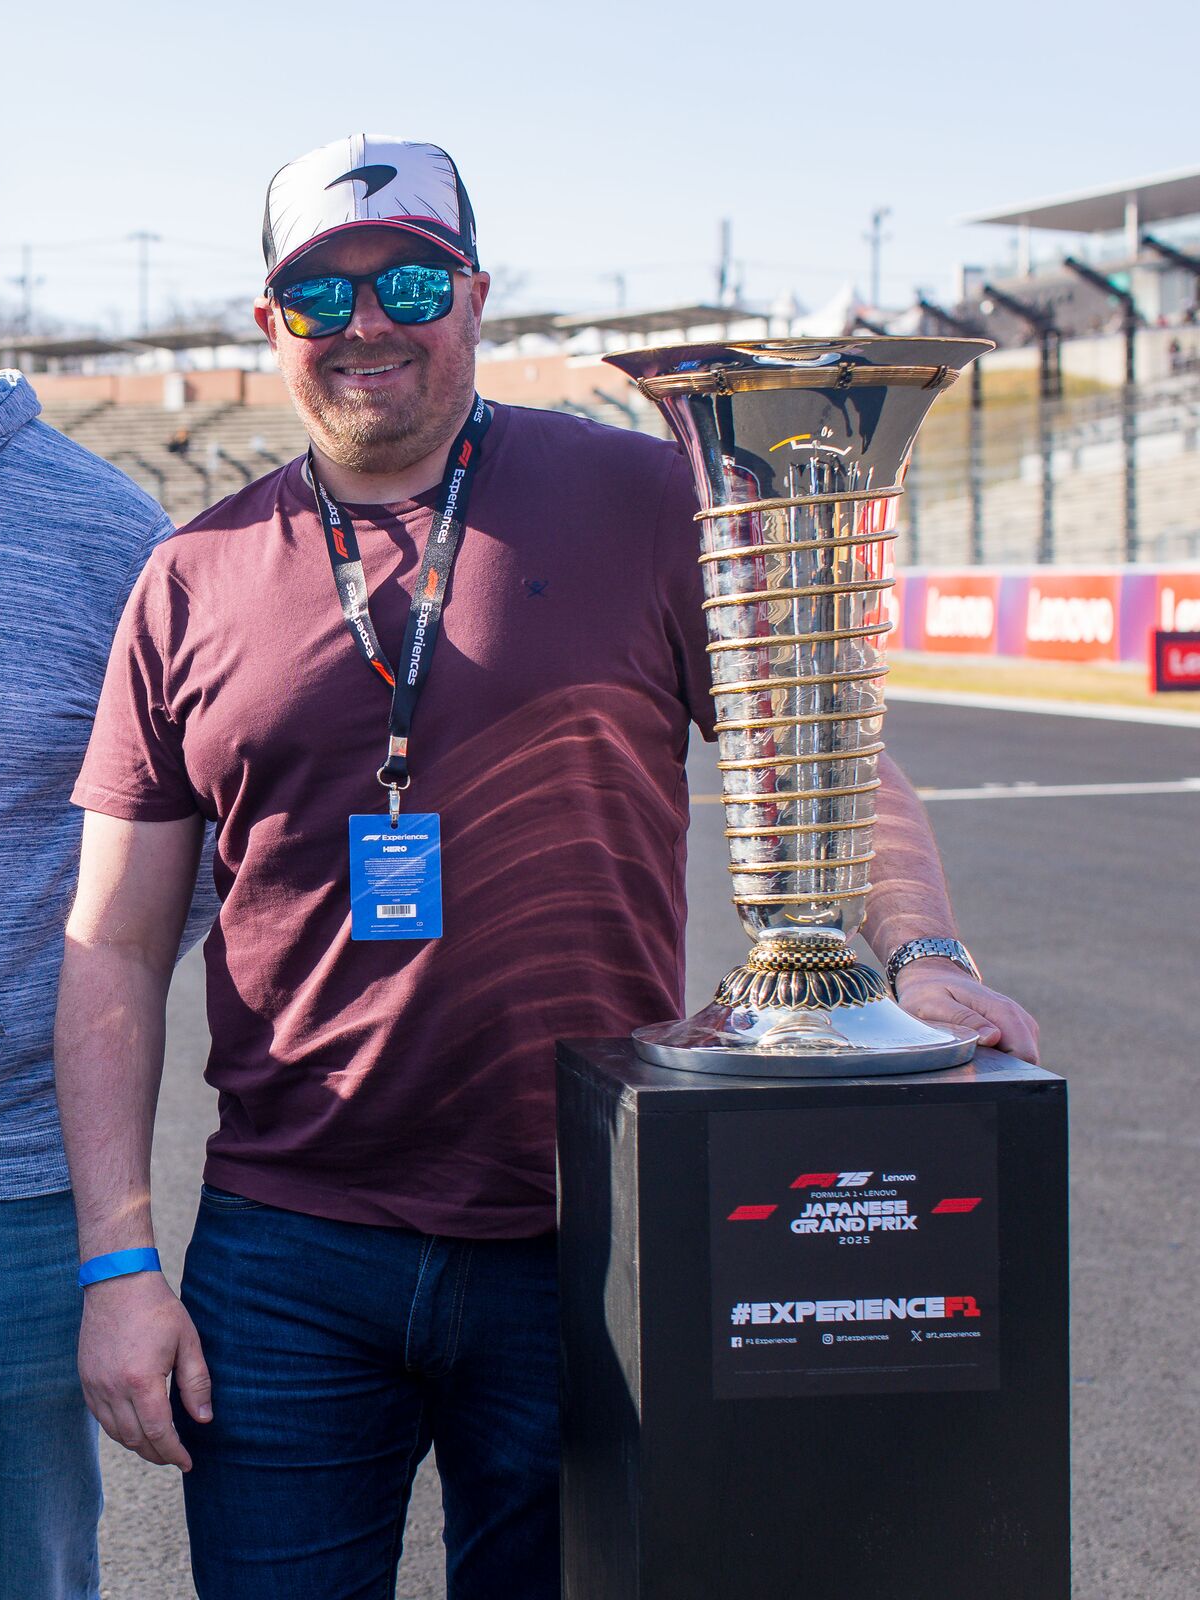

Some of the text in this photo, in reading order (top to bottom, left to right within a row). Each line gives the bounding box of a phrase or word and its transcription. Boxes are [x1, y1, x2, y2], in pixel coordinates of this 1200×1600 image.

[438, 439, 473, 544] F1 Experiences
[332, 527, 349, 559] F1
[346, 581, 375, 659] Experiences
[407, 602, 434, 686] Experiences
[382, 834, 429, 842] Experiences
[383, 845, 407, 853] HERO
[789, 1173, 839, 1189] F1
[882, 1174, 917, 1182] Lenovo
[800, 1200, 908, 1218] JAPANESE
[790, 1216, 918, 1234] GRAND PRIX
[838, 1236, 871, 1244] 2025
[730, 1296, 982, 1326] #EXPERIENCEF1
